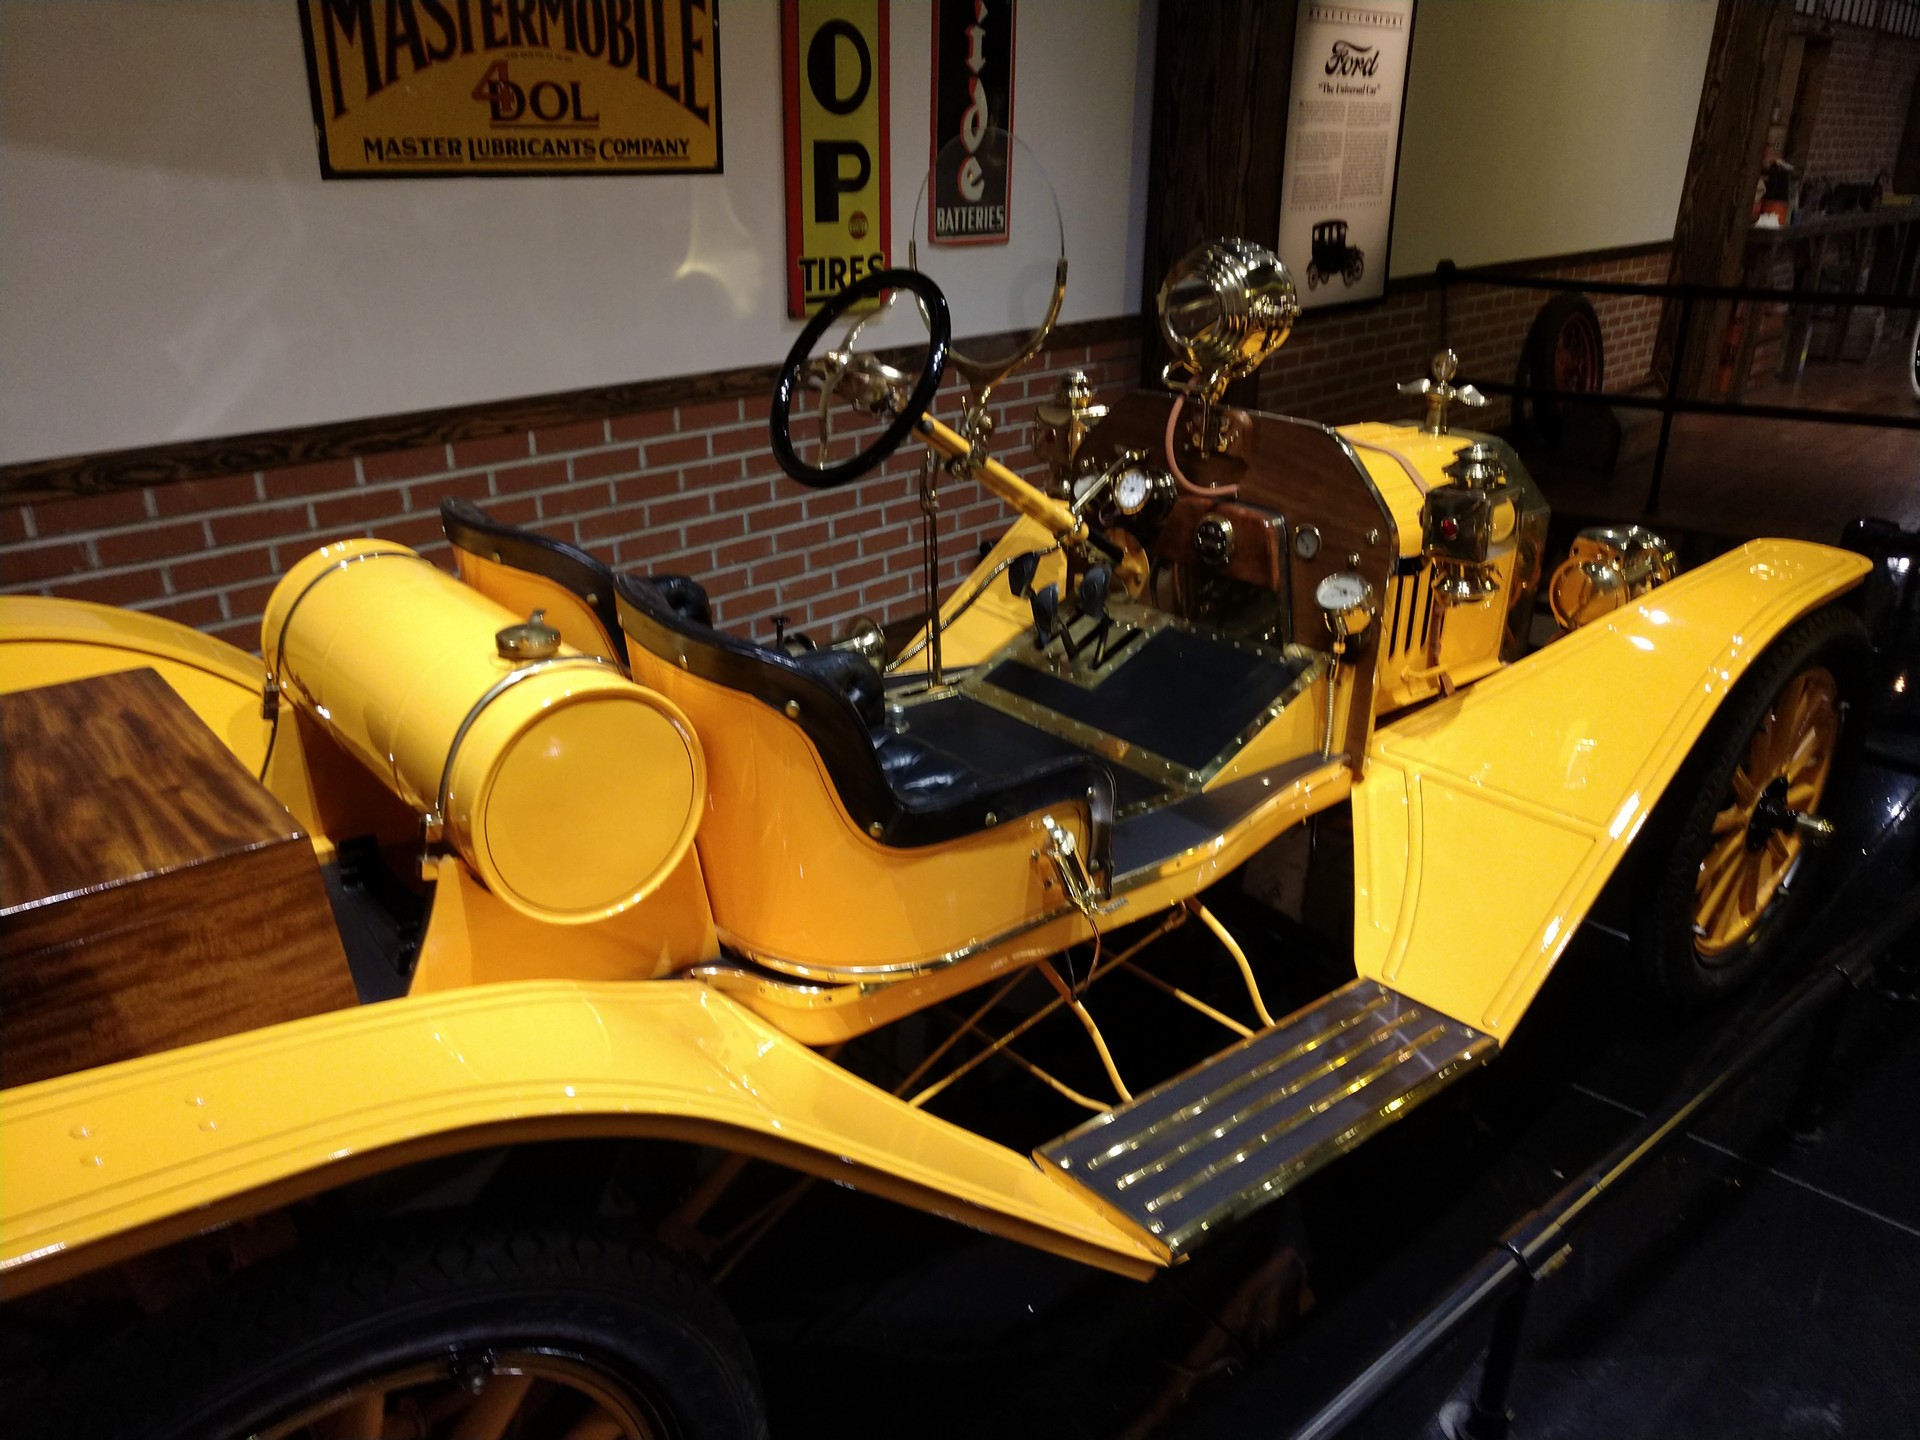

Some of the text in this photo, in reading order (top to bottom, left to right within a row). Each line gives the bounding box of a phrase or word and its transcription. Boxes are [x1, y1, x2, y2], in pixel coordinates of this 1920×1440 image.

[1325, 40, 1380, 77] Ford
[363, 137, 690, 162] MASTER LUBRICANTS COMPANY
[936, 204, 1004, 233] BATTERIES
